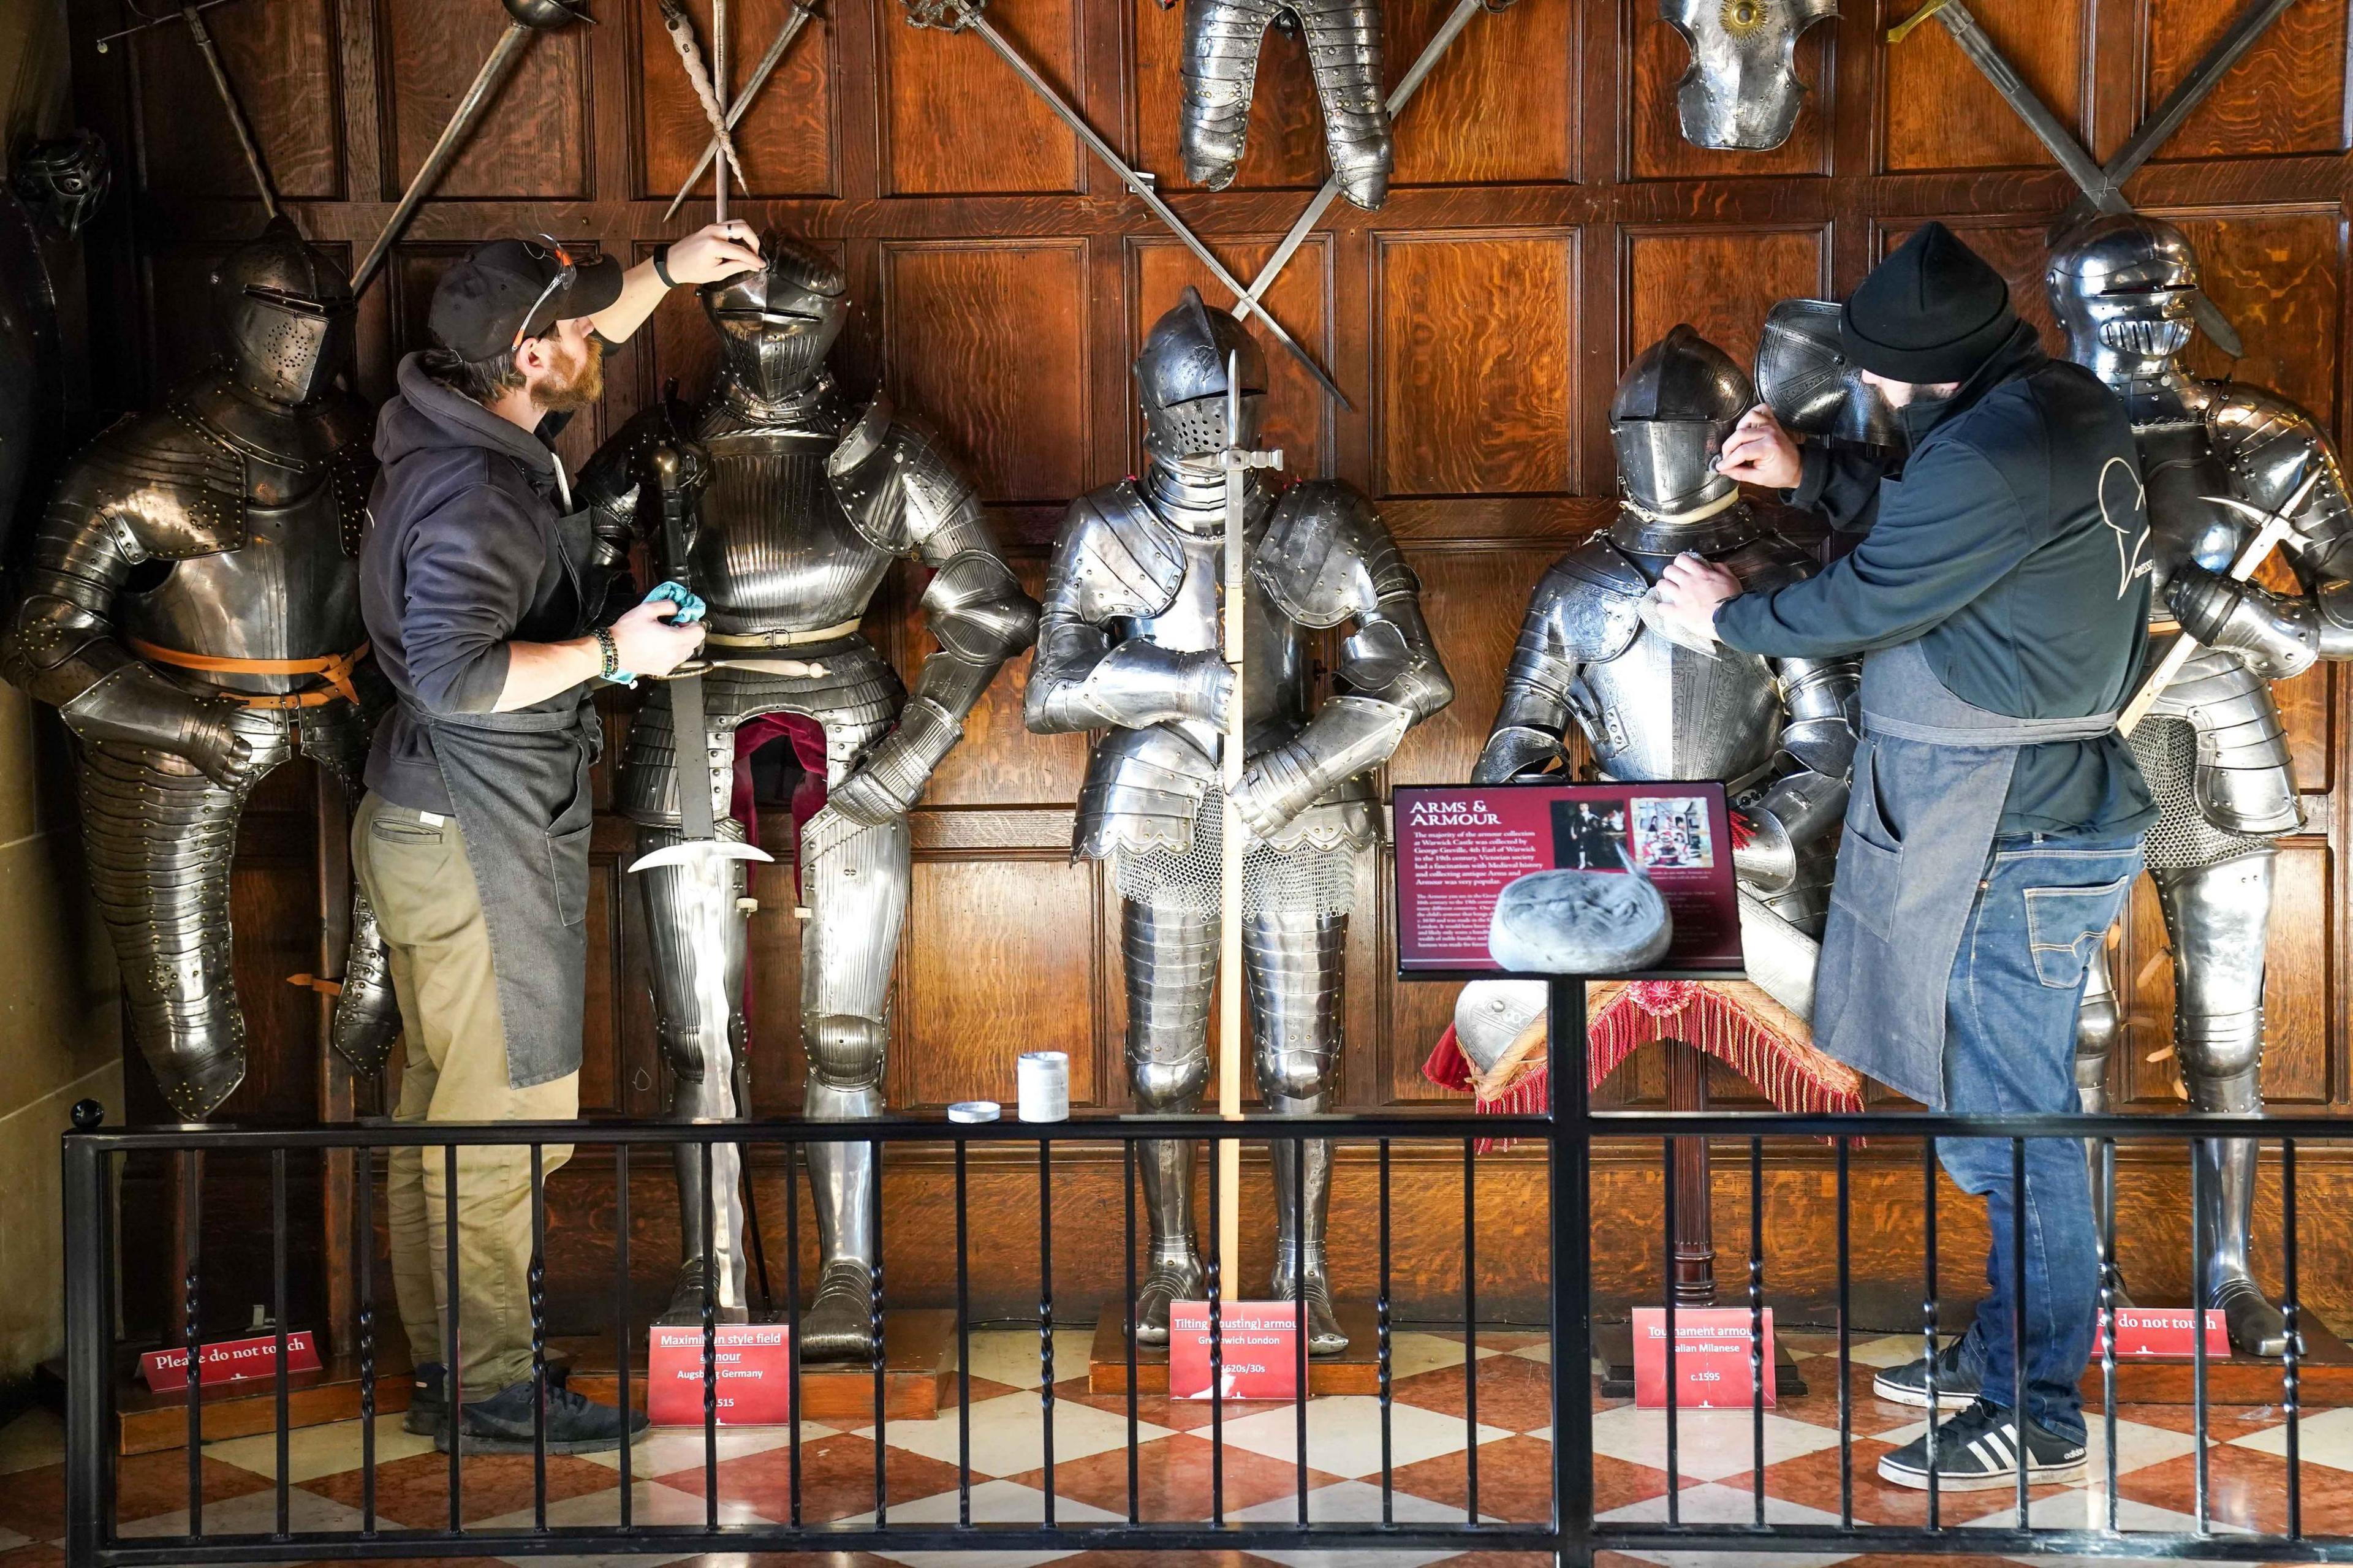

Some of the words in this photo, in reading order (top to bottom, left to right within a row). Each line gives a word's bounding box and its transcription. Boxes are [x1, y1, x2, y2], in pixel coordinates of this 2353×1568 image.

[1409, 801, 1466, 814] ARMS
[1473, 800, 1488, 812] &
[1410, 813, 1502, 826] ARMOUR
[1519, 862, 1544, 870] history
[1473, 878, 1502, 887] popular.
[1174, 1319, 1208, 1330] Tilting
[1219, 1318, 1261, 1330] ousting)
[2118, 1313, 2138, 1328] do
[2142, 1317, 2169, 1329] not
[2171, 1314, 2217, 1330] touh
[1648, 1326, 1715, 1336] Tounament
[1718, 1327, 1752, 1336] armou
[728, 1333, 753, 1346] style
[756, 1333, 781, 1344] field
[1247, 1336, 1280, 1345] London
[154, 1355, 206, 1369] Pleae
[209, 1349, 229, 1362] do
[233, 1346, 259, 1360] not
[262, 1338, 305, 1355] toch
[1675, 1343, 1697, 1352] alian
[1699, 1343, 1740, 1353] Milanese
[700, 1353, 742, 1362] amour
[1221, 1363, 1265, 1374] 1620s/30s
[677, 1369, 720, 1381] Augsbg
[721, 1368, 763, 1380] Germany
[1691, 1371, 1721, 1382] c.1595
[716, 1398, 735, 1407] 515
